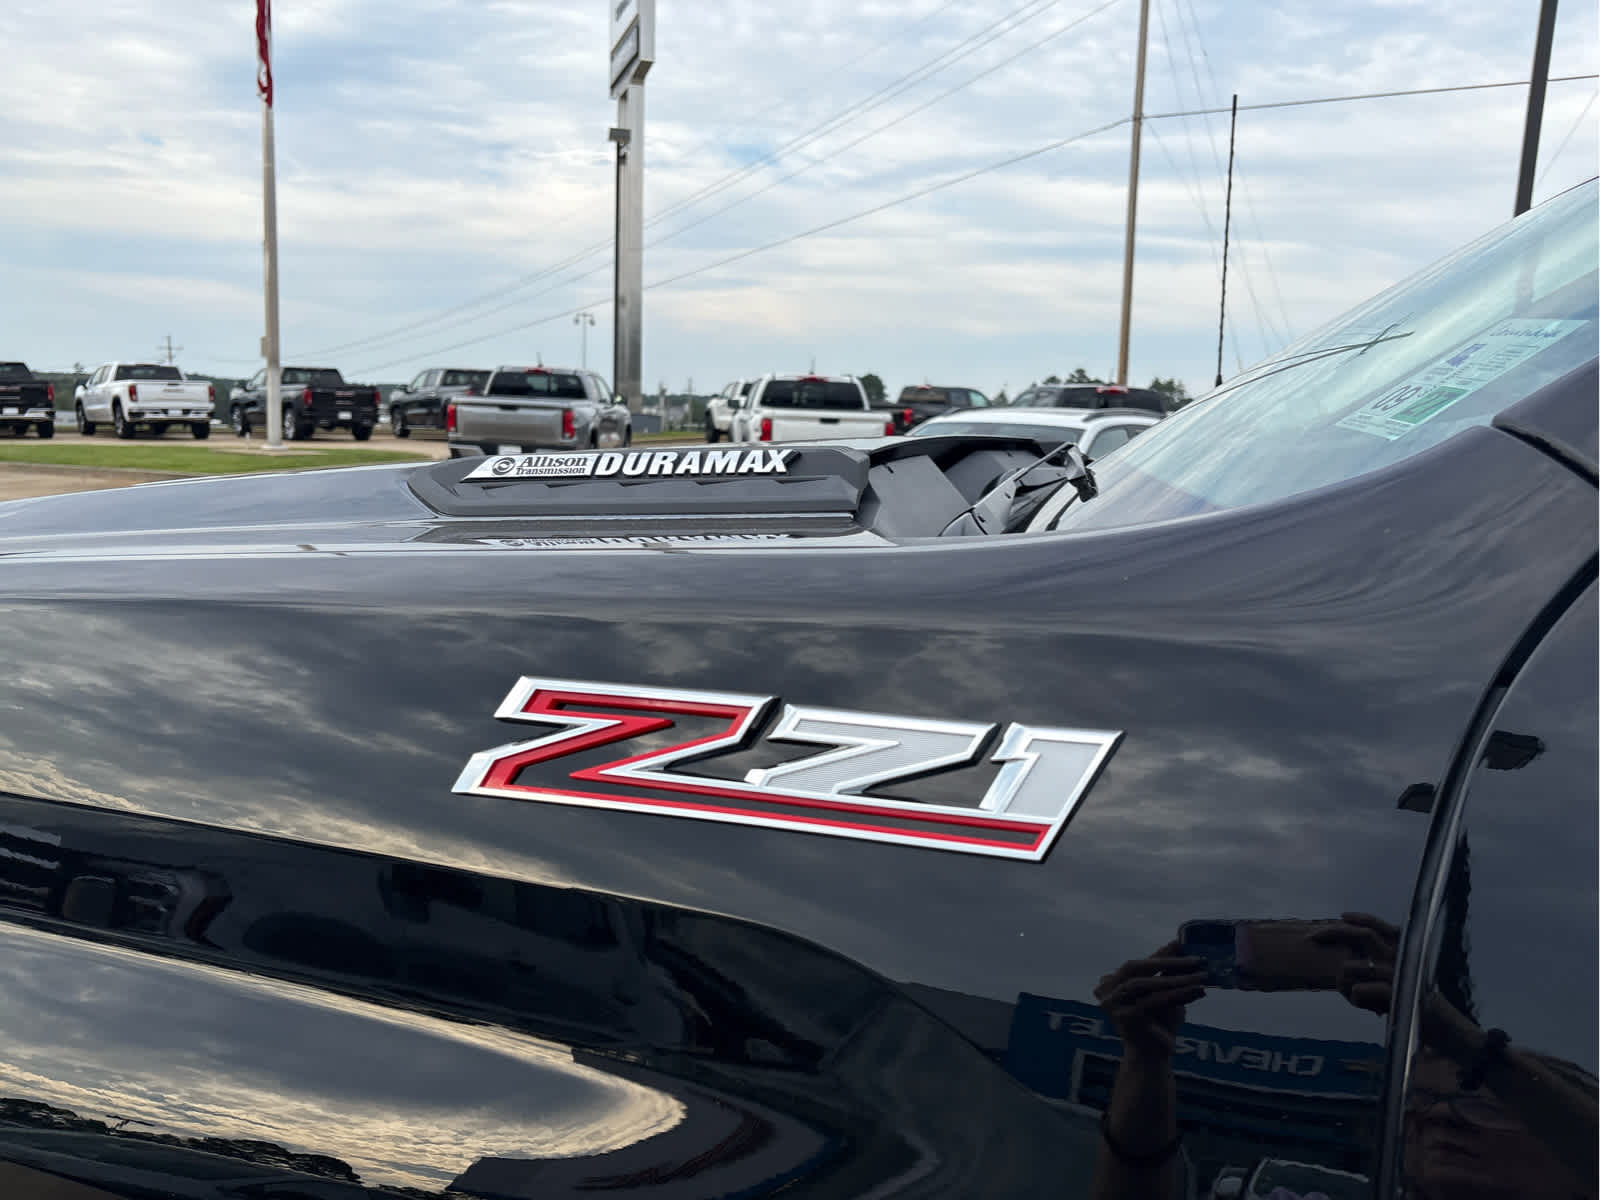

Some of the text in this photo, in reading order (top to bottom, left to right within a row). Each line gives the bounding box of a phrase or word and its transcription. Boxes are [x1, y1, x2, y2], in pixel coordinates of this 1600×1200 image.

[516, 466, 586, 476] Transmission
[518, 456, 588, 468] Allison
[595, 450, 791, 476] DURAMAX
[451, 676, 1124, 862] Z71
